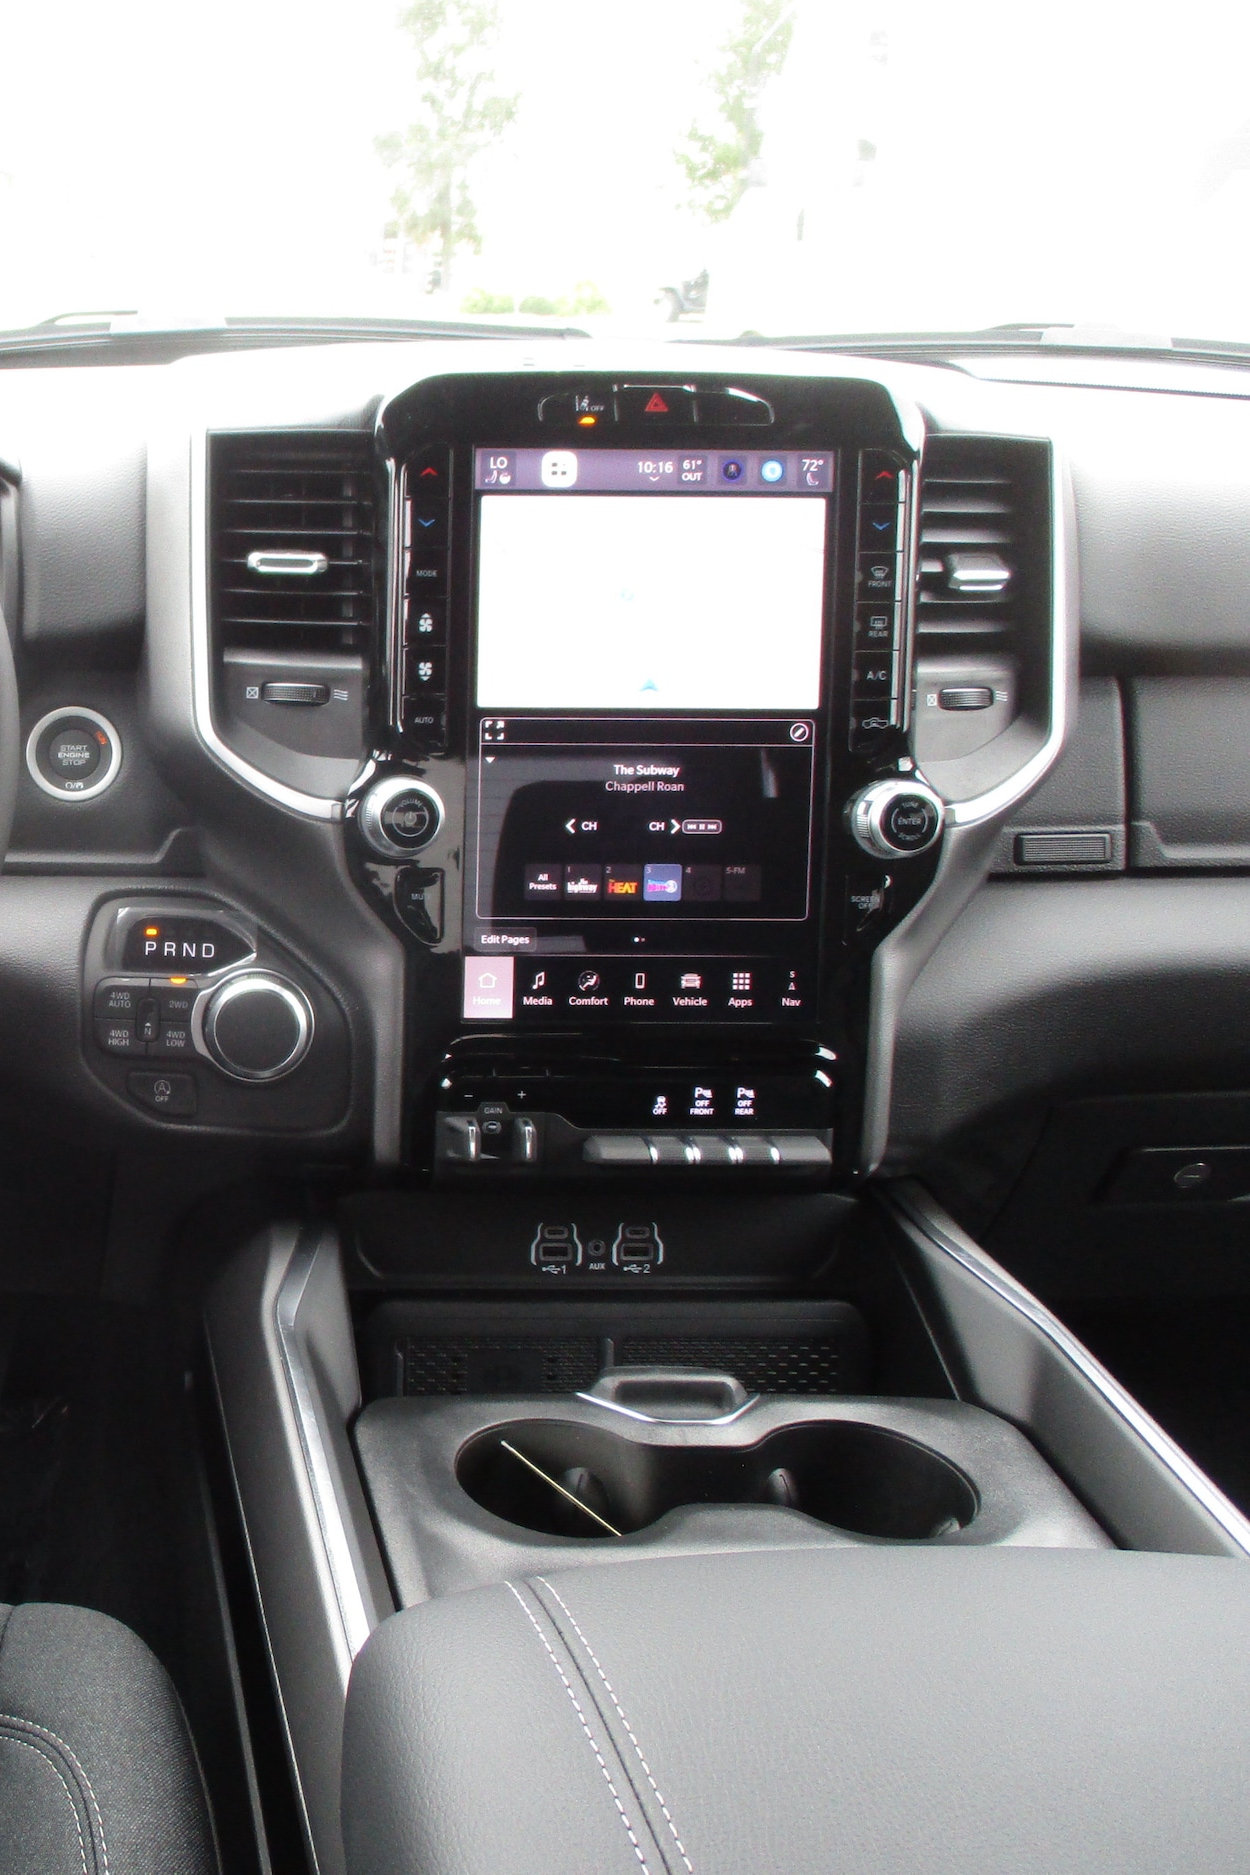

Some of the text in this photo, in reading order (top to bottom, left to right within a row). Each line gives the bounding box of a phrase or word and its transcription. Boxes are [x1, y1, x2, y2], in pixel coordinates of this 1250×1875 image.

[490, 457, 508, 469] LO
[637, 461, 673, 474] 10:16
[681, 472, 703, 482] OUT
[416, 569, 438, 578] MODE
[868, 580, 892, 588] FRONT
[868, 630, 888, 638] REAR
[866, 671, 887, 680] A/C
[414, 716, 434, 724] AUTO
[613, 764, 680, 779] The Subway
[605, 780, 685, 795] Chappell Roan
[398, 799, 424, 808] VOLUME
[581, 821, 598, 831] CH
[649, 821, 665, 831] CH
[898, 817, 922, 826] ENTER
[538, 873, 548, 881] All
[529, 882, 557, 890] Presets
[567, 882, 598, 893] highway
[607, 881, 638, 894] HEAT
[851, 895, 880, 903] SCREEN
[481, 934, 530, 947] Edit Pages
[110, 992, 130, 1000] 4WD
[473, 996, 501, 1005] Home
[568, 995, 608, 1006] Comfort
[109, 1000, 131, 1008] AUTO
[169, 1001, 188, 1009] 2WD
[523, 996, 553, 1006] Media
[624, 996, 654, 1006] Phone
[672, 996, 707, 1006] Vehicle
[728, 996, 753, 1009] Apps
[781, 997, 801, 1007] Nav
[110, 1030, 129, 1038] 4WD
[144, 1027, 152, 1035] N
[166, 1031, 185, 1039] 4WD
[108, 1039, 129, 1047] HIGH
[166, 1039, 186, 1047] LOW
[484, 1106, 503, 1114] GAIN
[589, 1263, 606, 1271] AUX
